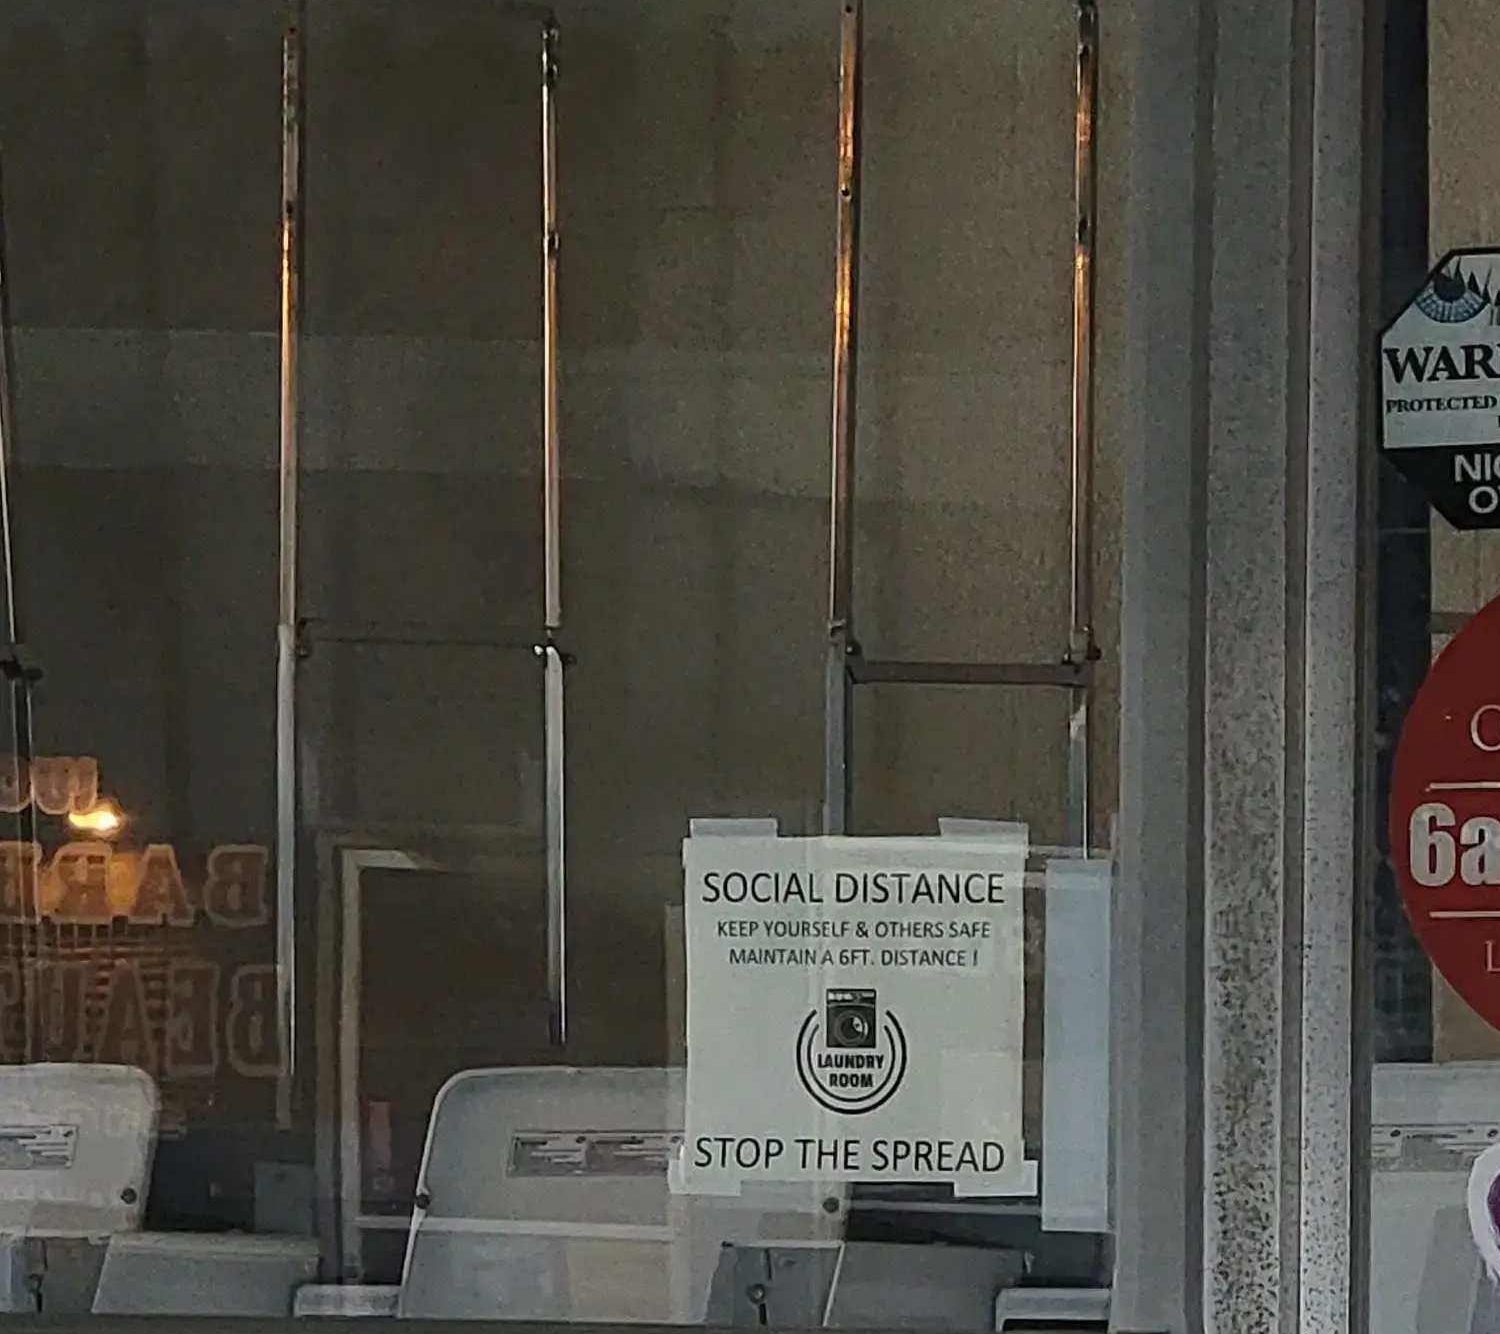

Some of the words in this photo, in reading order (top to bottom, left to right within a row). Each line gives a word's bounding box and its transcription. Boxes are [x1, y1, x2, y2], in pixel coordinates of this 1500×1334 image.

[1386, 395, 1498, 413] PROTECTED
[702, 871, 824, 904] SOCIAL
[835, 872, 1006, 905] DISTANCE
[717, 920, 759, 937] KEEP
[763, 920, 850, 938] YOURSELF
[855, 921, 869, 938] &
[875, 921, 944, 938] OTHERS
[949, 921, 991, 938] SAFE
[729, 948, 816, 966] MAINTAIN
[821, 949, 834, 965] A
[839, 949, 875, 966] 6FT.
[881, 949, 966, 966] DISTANCE
[817, 1053, 885, 1070] LAUNDRY
[829, 1072, 874, 1088] ROOM
[694, 1137, 784, 1169] STOP
[794, 1139, 861, 1170] THE
[871, 1139, 1006, 1172] SPREAD
